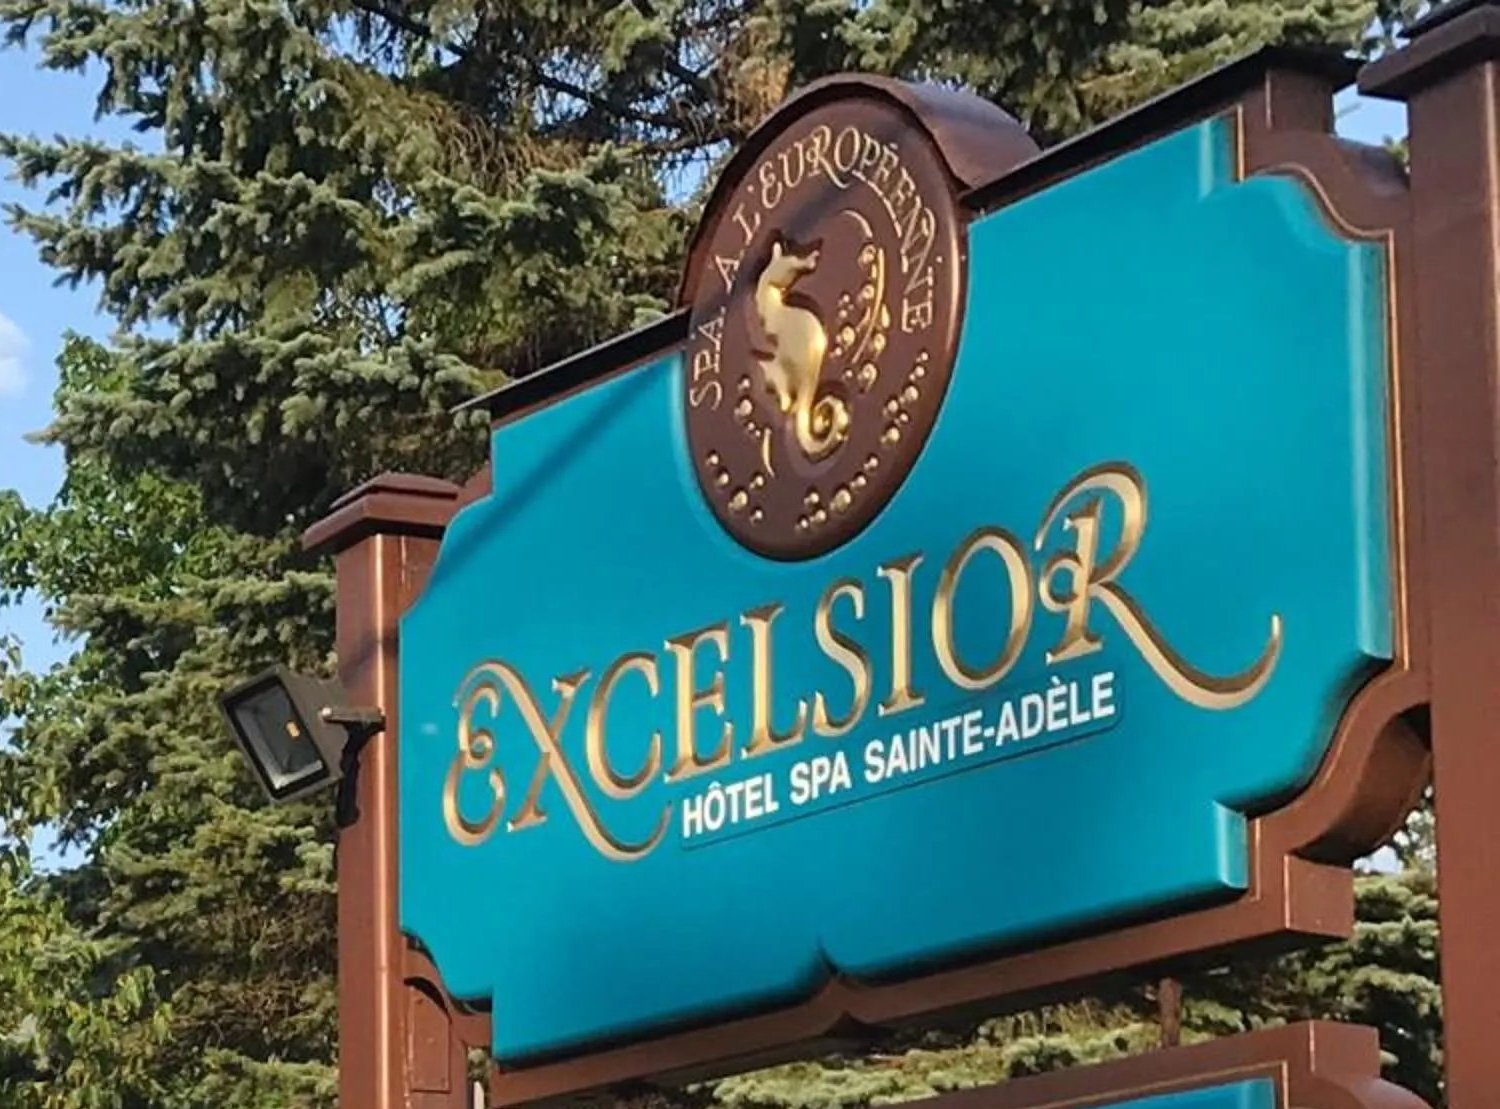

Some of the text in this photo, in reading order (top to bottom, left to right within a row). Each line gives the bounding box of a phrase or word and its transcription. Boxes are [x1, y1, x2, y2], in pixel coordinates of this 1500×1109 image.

[441, 460, 1282, 863] EXCELSIOR
[682, 671, 1116, 839] HÔTEL SPA SAINTE-ADÈLE
